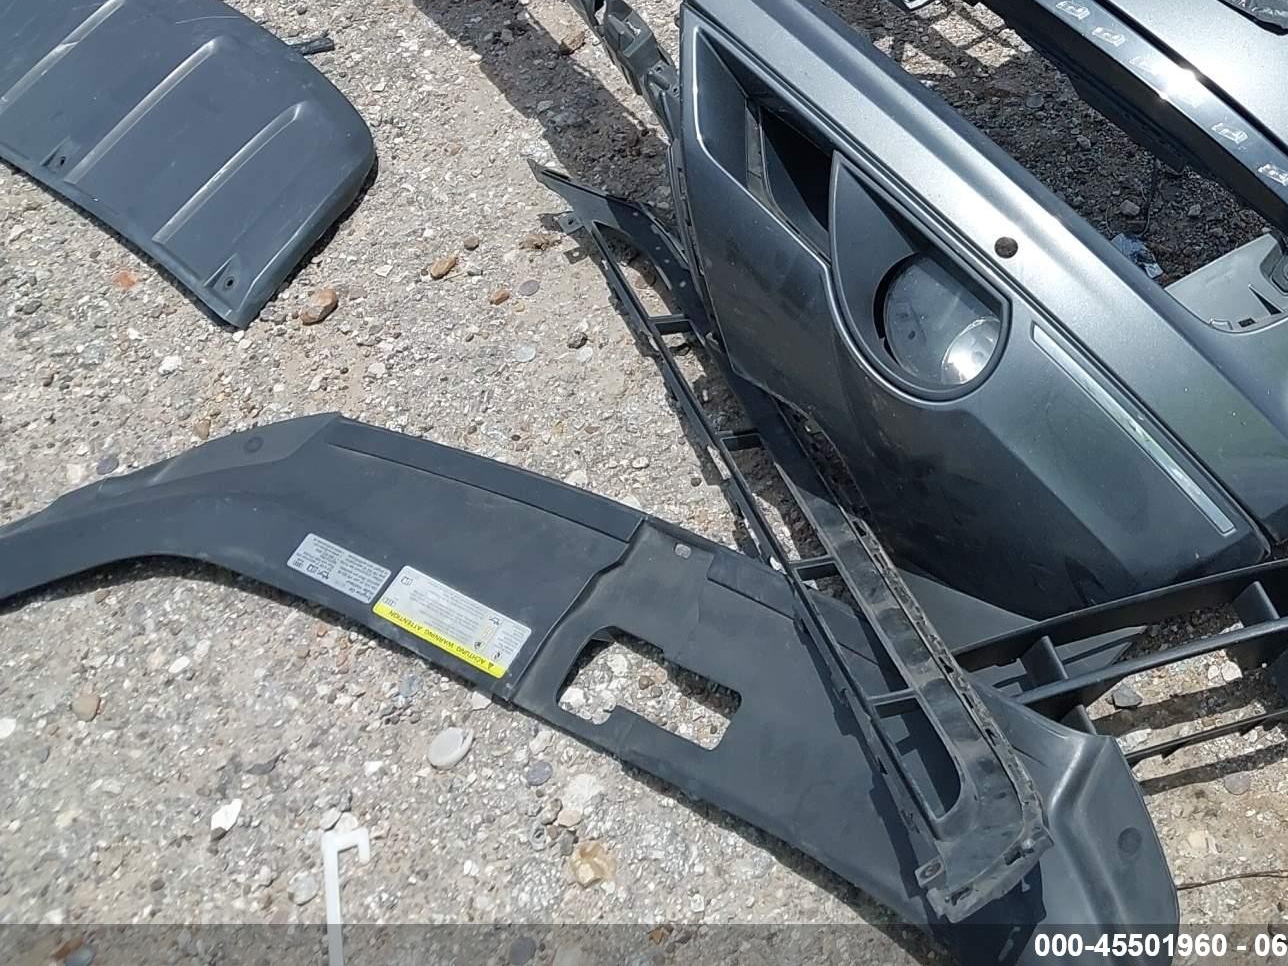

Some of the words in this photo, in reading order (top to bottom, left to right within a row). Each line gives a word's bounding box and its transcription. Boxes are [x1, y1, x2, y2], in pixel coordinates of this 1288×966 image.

[388, 610, 422, 631] ATTENTION
[423, 629, 454, 648] WARNING
[455, 646, 486, 665] ACHTUNG
